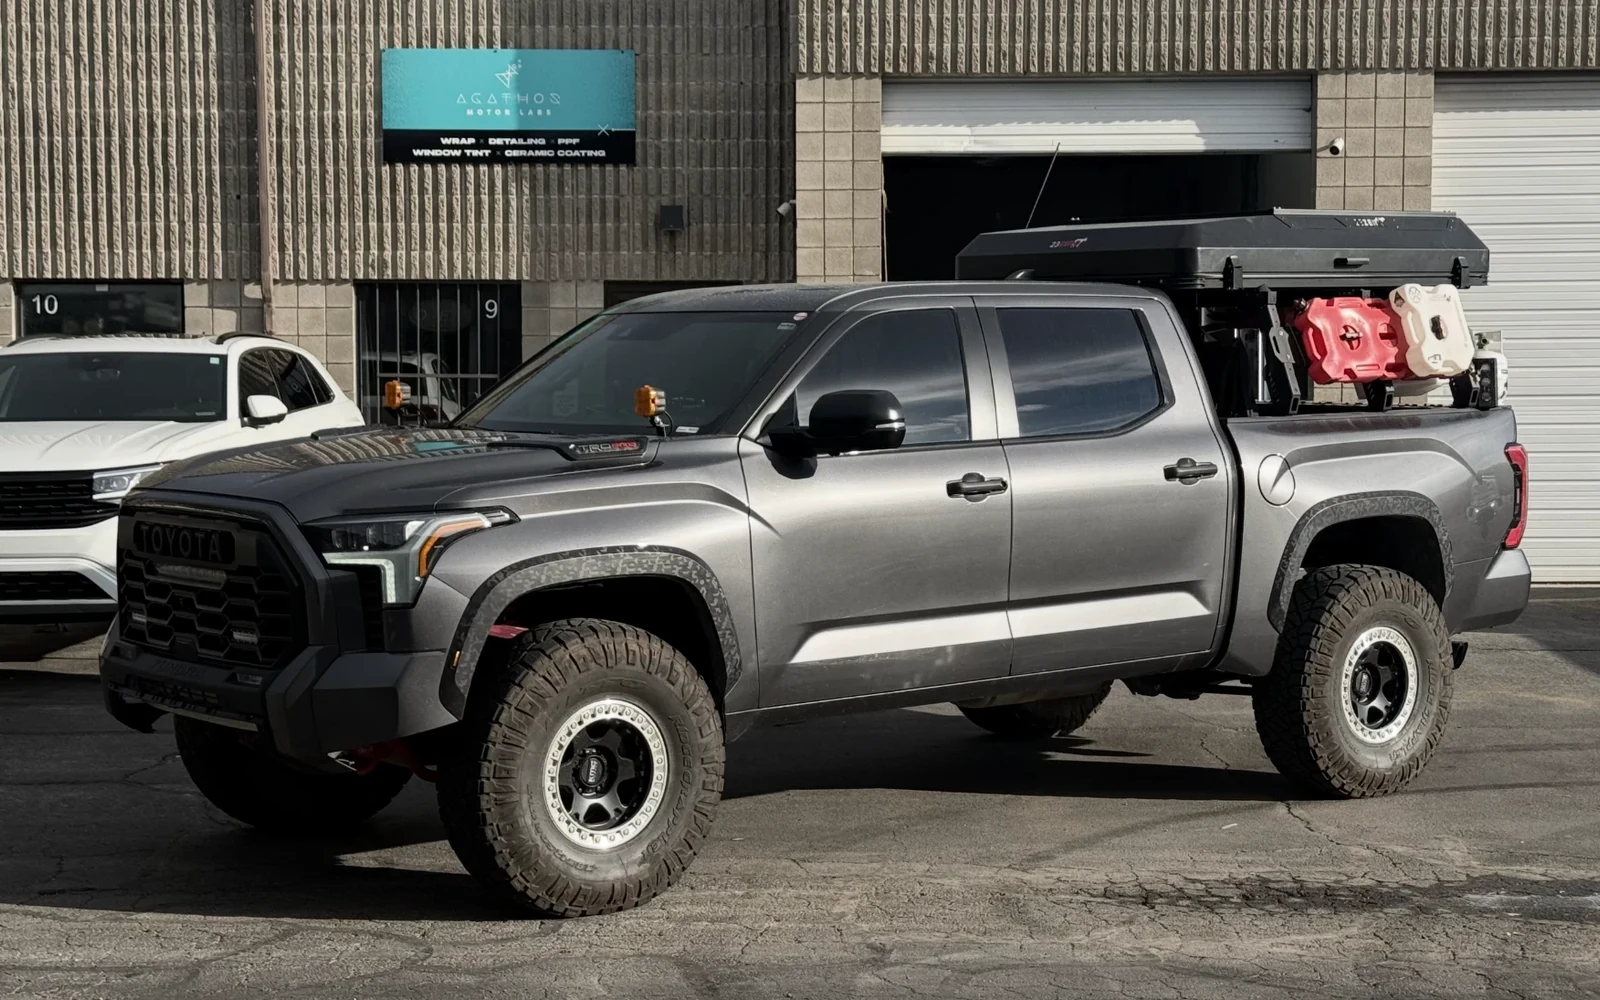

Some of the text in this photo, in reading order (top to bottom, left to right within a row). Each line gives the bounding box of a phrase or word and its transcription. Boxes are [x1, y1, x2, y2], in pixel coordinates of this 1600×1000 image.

[456, 93, 561, 104] AGATHOS
[440, 137, 580, 145] WRAP DETAILING PPF
[412, 149, 606, 157] WINDOW TINT CERAMIC COATING
[31, 294, 59, 315] 10
[485, 299, 498, 319] 9
[140, 523, 223, 562] TOYOTA
[668, 715, 693, 769] RIDGE
